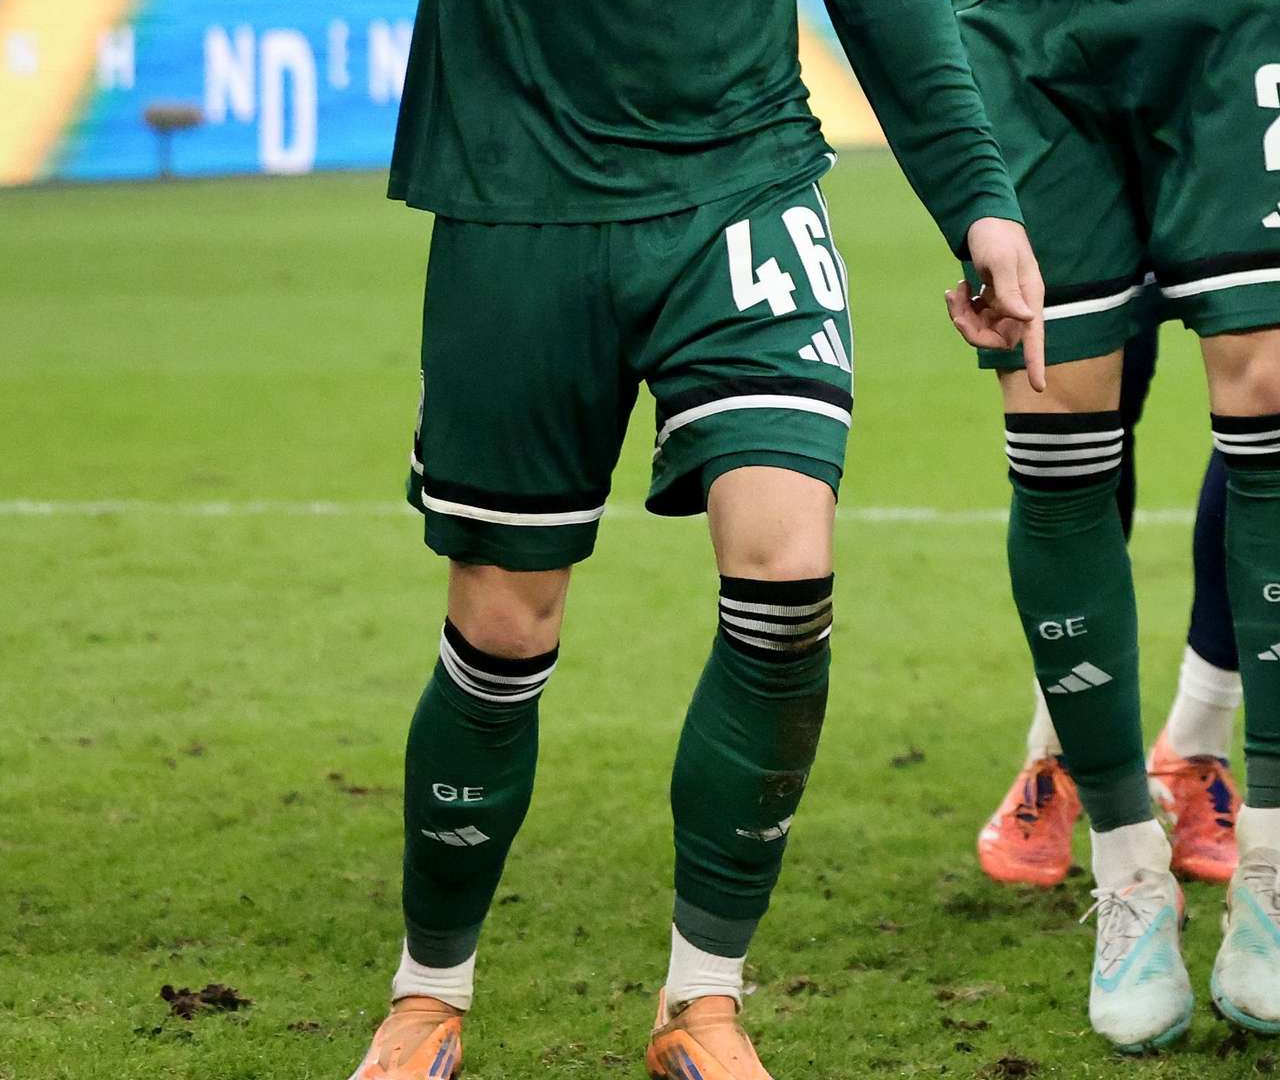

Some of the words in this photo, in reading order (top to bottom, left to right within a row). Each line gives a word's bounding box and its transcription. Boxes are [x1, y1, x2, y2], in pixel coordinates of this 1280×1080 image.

[725, 206, 845, 317] 46
[1039, 616, 1088, 640] GE
[432, 783, 484, 802] GE
